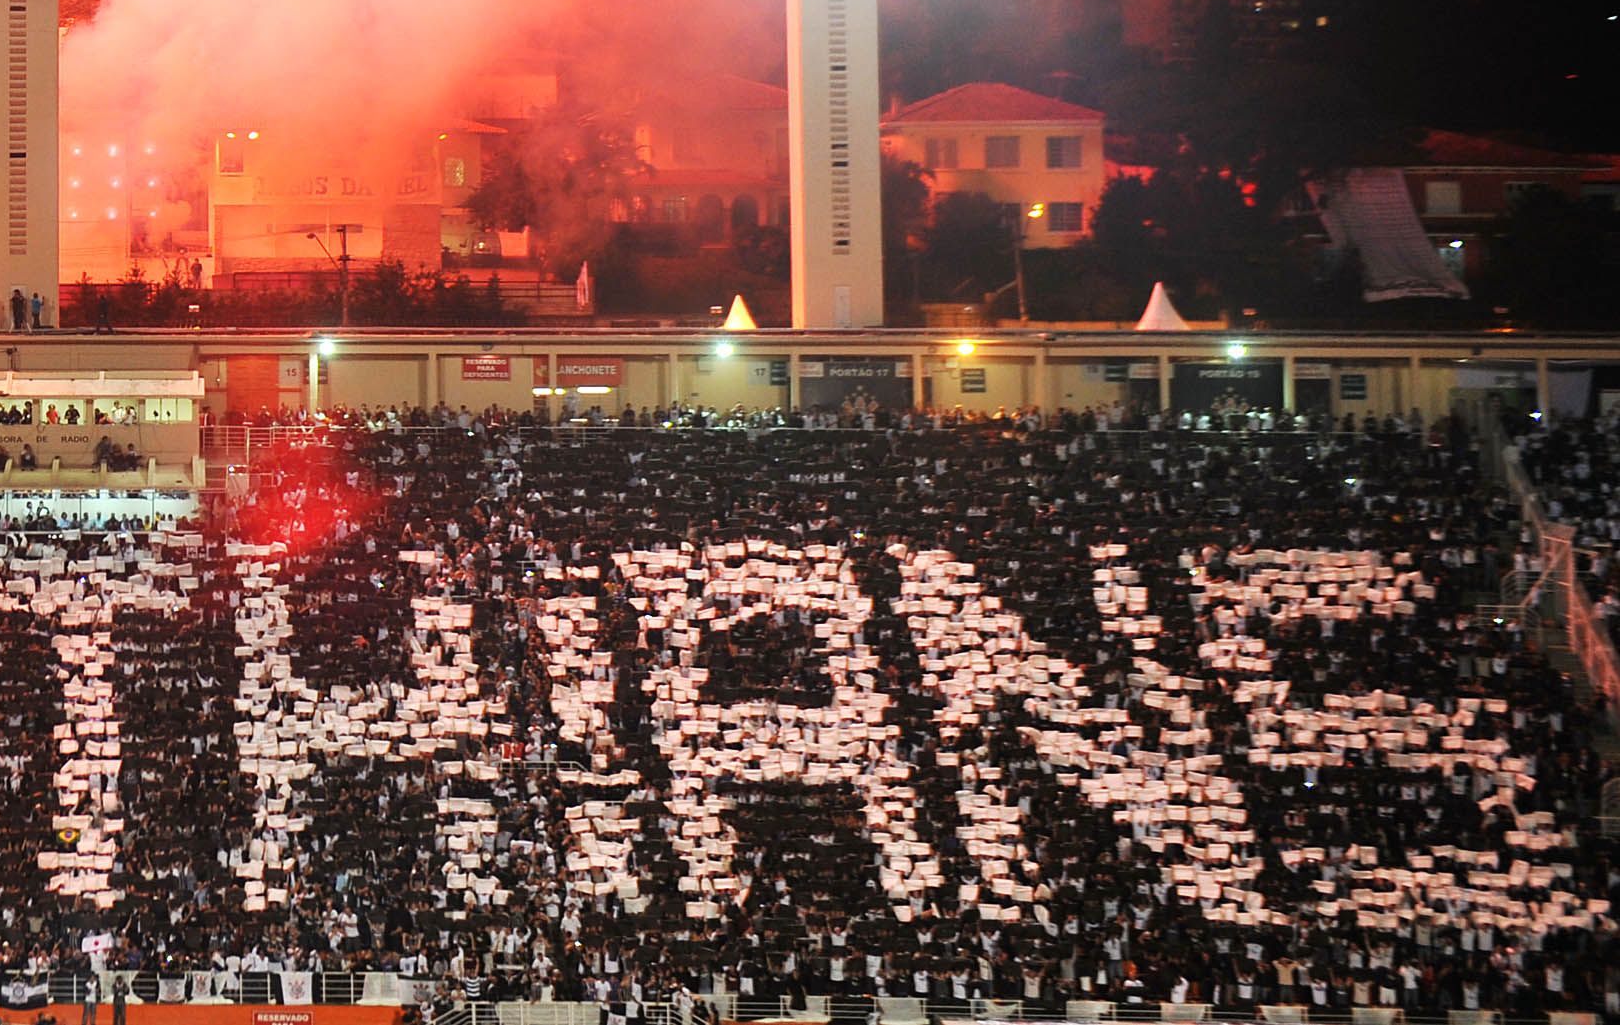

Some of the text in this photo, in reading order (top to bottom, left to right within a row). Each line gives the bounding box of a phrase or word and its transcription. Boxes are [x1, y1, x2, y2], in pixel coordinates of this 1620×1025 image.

[286, 368, 297, 377] 15
[875, 368, 889, 377] 17
[36, 435, 48, 444] DE
[257, 1013, 309, 1022] RESERVADO
